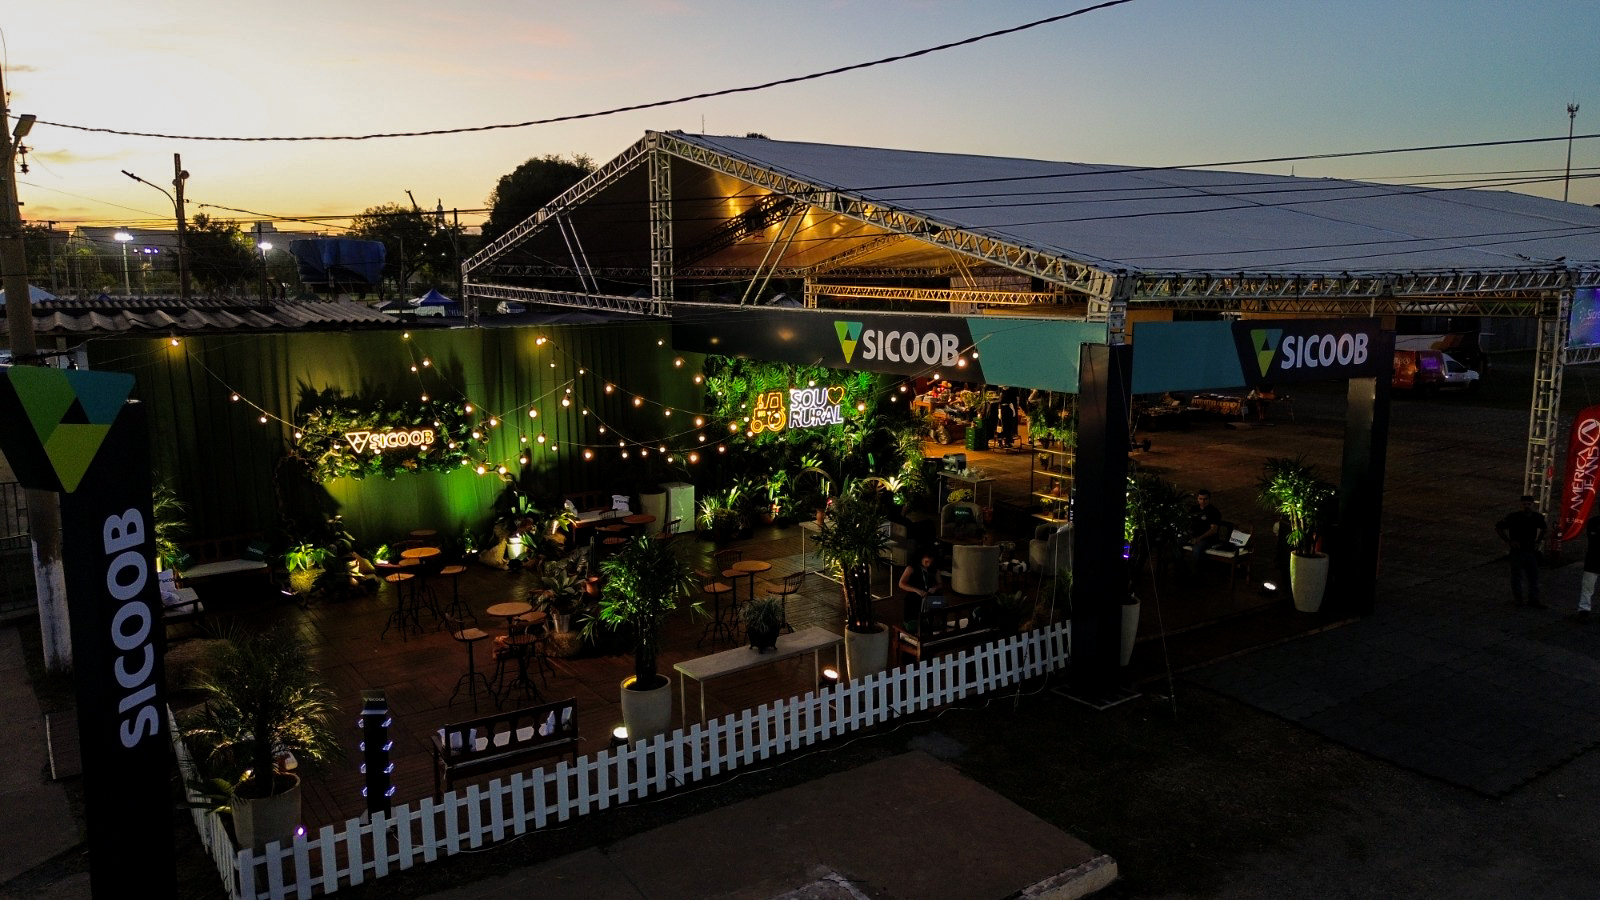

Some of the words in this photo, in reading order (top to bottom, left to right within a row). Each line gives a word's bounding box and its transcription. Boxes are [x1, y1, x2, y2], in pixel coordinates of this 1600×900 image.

[862, 329, 960, 367] SICOOB
[1281, 333, 1369, 370] SICOOB
[788, 404, 843, 428] RURAL
[790, 387, 828, 410] SOU
[369, 430, 434, 450] SICOOB
[1583, 446, 1600, 494] JEANS
[103, 508, 159, 748] SICOOB
